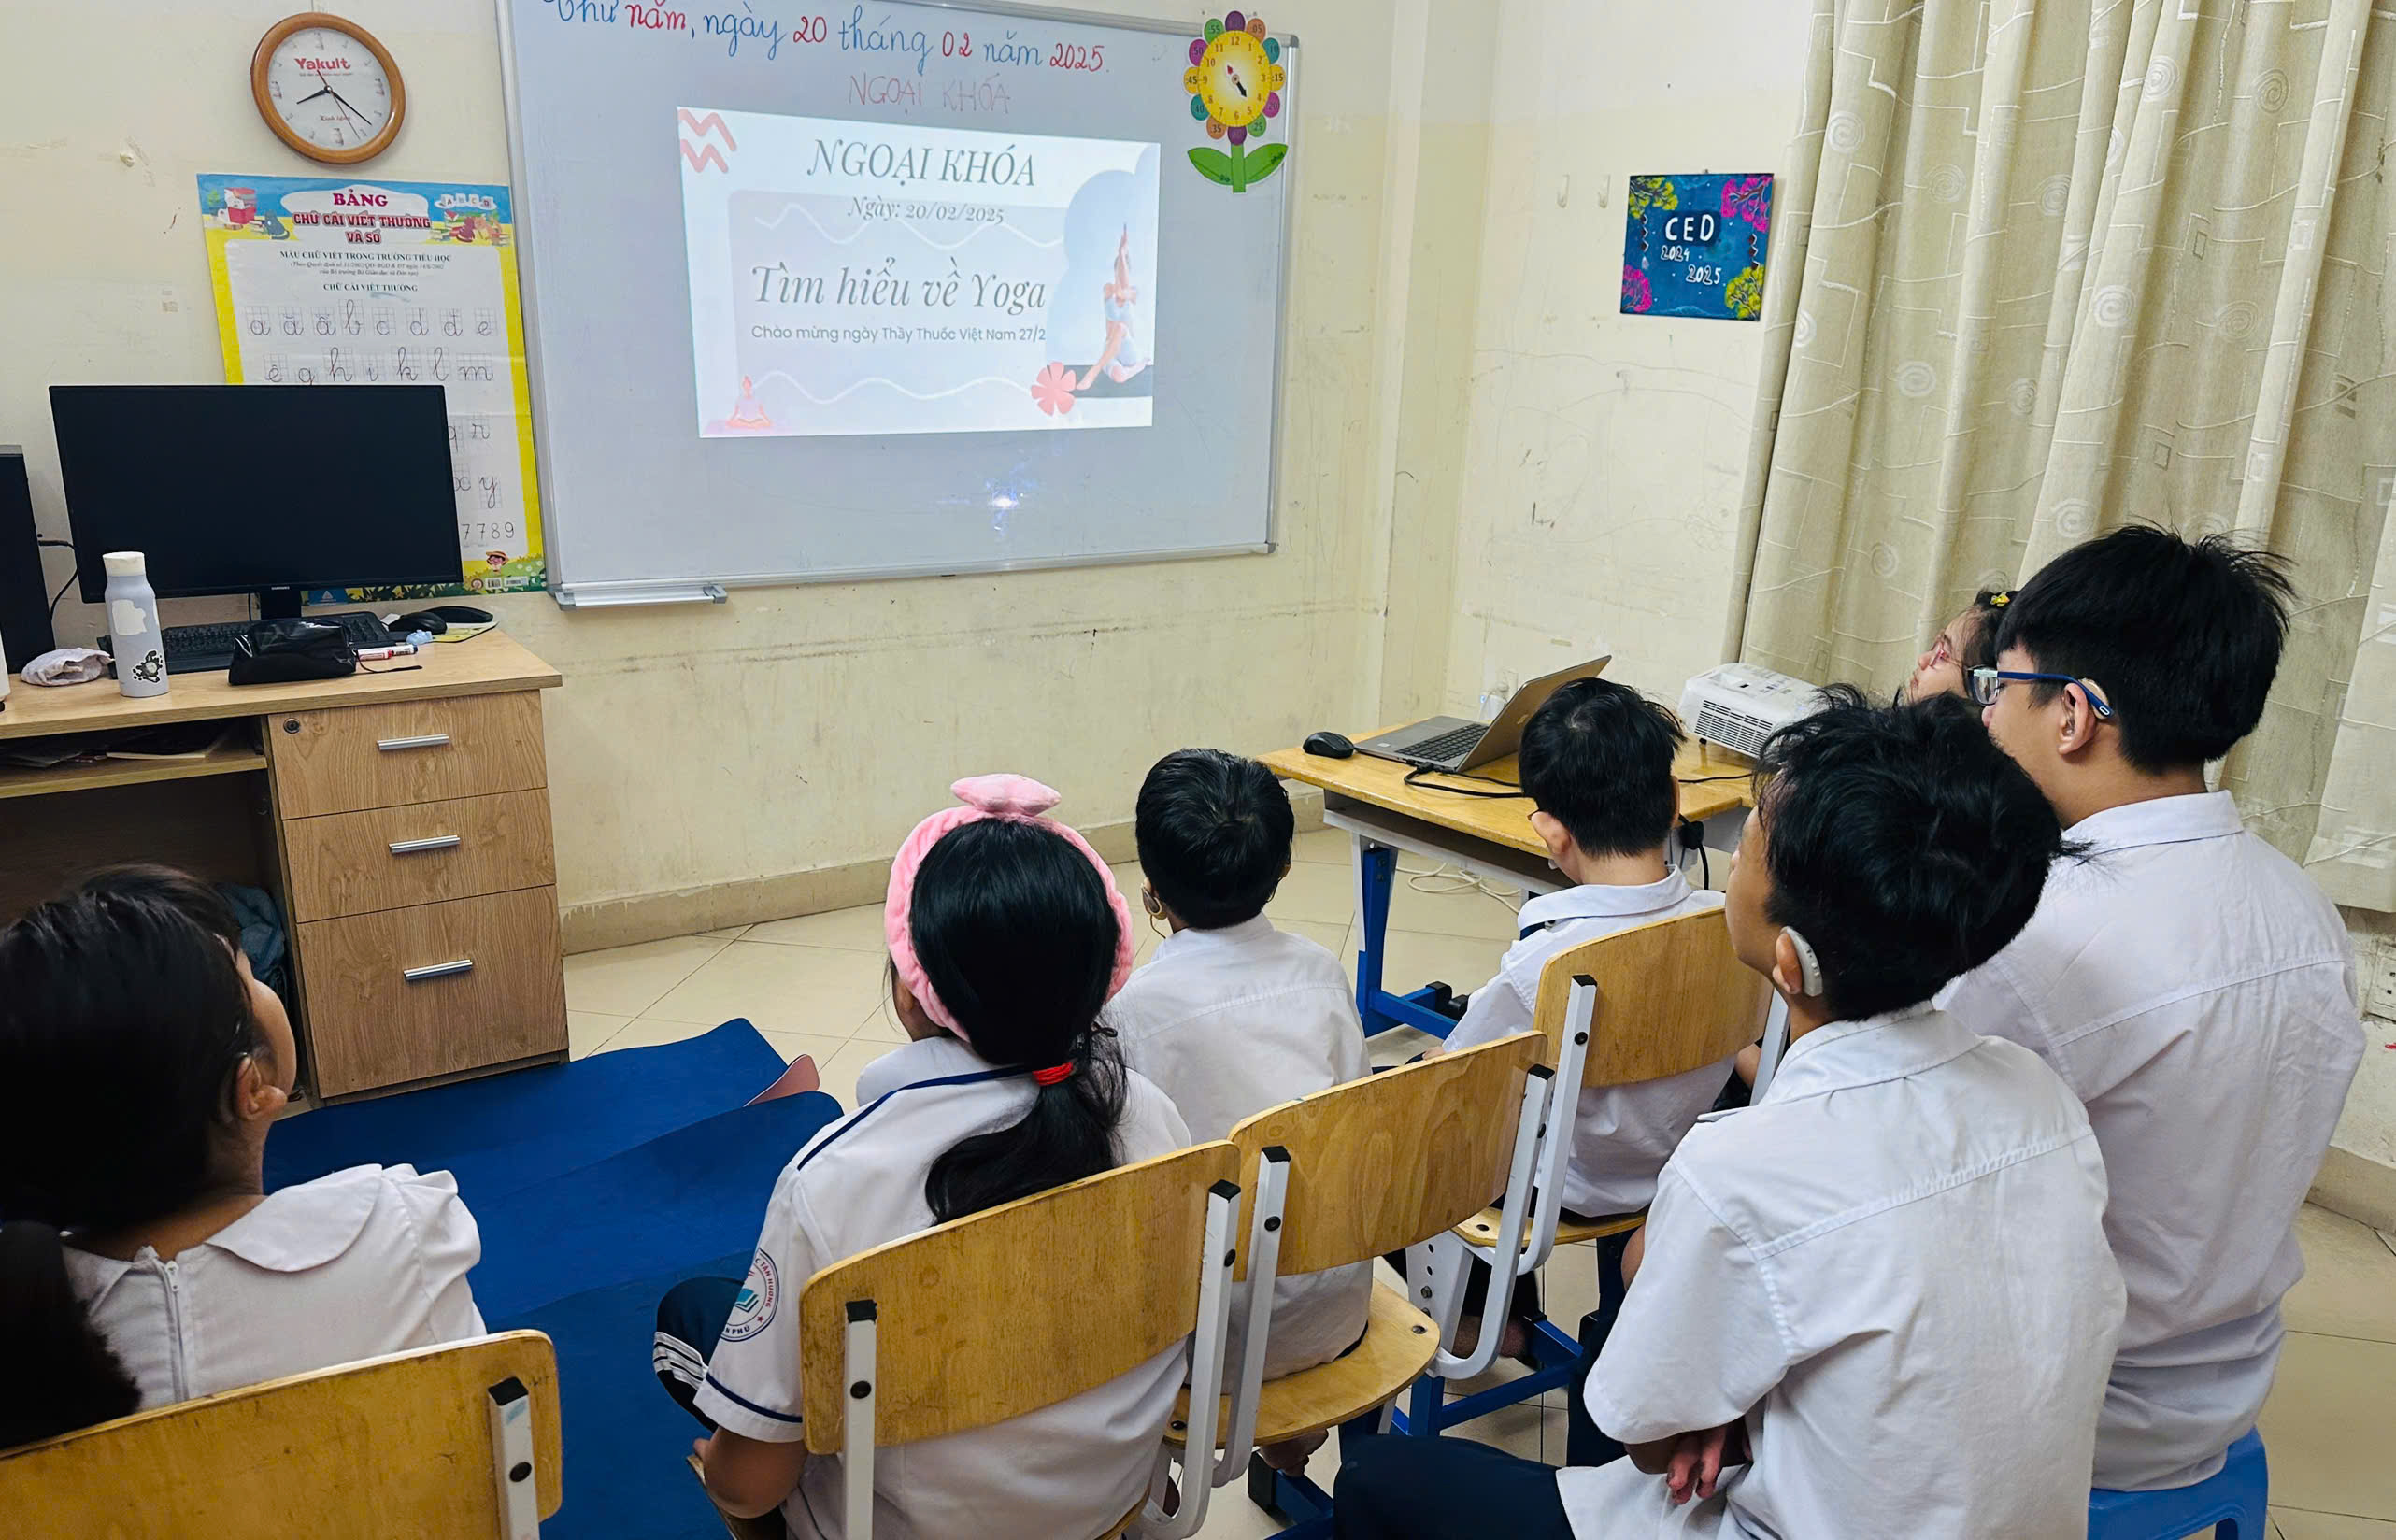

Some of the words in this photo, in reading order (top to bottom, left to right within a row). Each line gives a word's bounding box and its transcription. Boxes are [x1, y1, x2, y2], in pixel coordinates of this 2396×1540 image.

[703, 1, 788, 60] ngày
[792, 16, 827, 43] 20
[838, 5, 934, 76] tháng
[942, 31, 973, 57] 02
[984, 30, 1043, 66] năm
[1231, 36, 1240, 45] 12
[294, 58, 351, 70] Yakult
[1206, 58, 1215, 67] 10
[1258, 56, 1262, 64] 2
[849, 73, 923, 114] NGOẠI
[942, 73, 1011, 113] KHÓA
[806, 138, 933, 187] NGOẠI
[939, 143, 1035, 187] KHÓA
[333, 189, 389, 207] BẢNG
[322, 211, 345, 226] CÁI
[347, 210, 376, 227] VIẾT
[848, 195, 901, 221] Ngày:
[906, 201, 1005, 226] 20/02/2025
[346, 230, 364, 244] VÀ
[364, 229, 382, 244] SỐ
[1665, 214, 1715, 242] CED
[346, 252, 375, 261] TRONG
[1660, 245, 1690, 263] 2024
[1686, 264, 1722, 286] 2025
[751, 262, 825, 304] Tìm
[836, 256, 910, 306] hiểu
[922, 256, 962, 307] về
[972, 273, 1047, 316] Yoga
[250, 319, 271, 336] a
[283, 314, 305, 336] ă
[344, 299, 362, 336] b
[376, 321, 391, 336] c
[409, 308, 430, 336] d
[443, 309, 464, 337] đ
[477, 321, 492, 336] e
[751, 324, 792, 339] Chào
[796, 325, 839, 343] mừng
[843, 326, 879, 343] ngày
[882, 325, 914, 344] Thầy
[916, 325, 957, 340] Thuốc
[959, 327, 983, 342] Việt
[986, 328, 1017, 341] Nam
[1019, 328, 1047, 342] 27/2
[267, 364, 284, 383] ê
[330, 346, 353, 381] h
[365, 364, 379, 381] i
[396, 346, 419, 381] k
[457, 366, 494, 381] m
[478, 475, 498, 509] y
